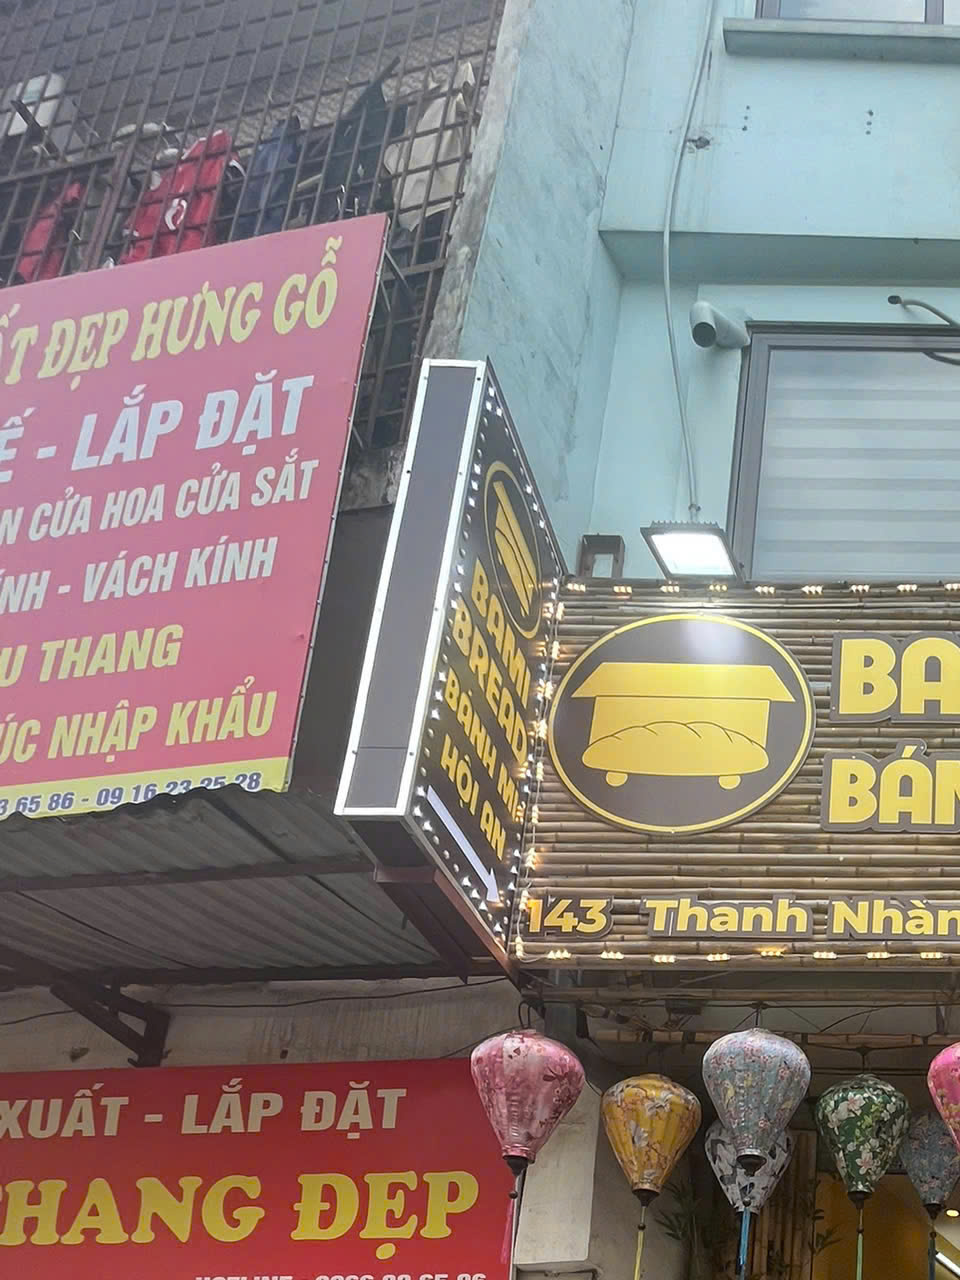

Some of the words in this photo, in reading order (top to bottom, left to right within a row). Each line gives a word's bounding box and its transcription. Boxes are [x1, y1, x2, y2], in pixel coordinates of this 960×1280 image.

[38, 309, 129, 391] ĐẸP
[131, 281, 263, 362] HƯNG
[273, 235, 343, 335] GỖ
[71, 384, 183, 471] LẮP
[195, 369, 315, 455] ĐẶT
[28, 487, 90, 541] CỬA
[100, 482, 165, 531] HOA
[175, 462, 241, 519] CỬA
[250, 448, 320, 507] SẮT
[82, 551, 178, 603] VÁCH
[185, 536, 279, 588] KÍNH
[39, 625, 184, 679] THANG
[471, 559, 531, 709] BAMI
[48, 700, 157, 763] NHẬP
[165, 676, 278, 747] KHẨU
[453, 597, 528, 766] BREAD
[15, 794, 41, 813] 65
[47, 792, 75, 811] 86
[96, 787, 124, 806] 09
[132, 783, 157, 802] 16
[480, 800, 506, 861] AN
[527, 899, 609, 934] 143
[646, 898, 808, 934] Thanh
[0, 1083, 129, 1139] XUẤT
[181, 1078, 284, 1135] LẮP
[300, 1081, 408, 1140] ĐẶT
[0, 1173, 266, 1247] HANG
[291, 1170, 480, 1260] ĐẸP
